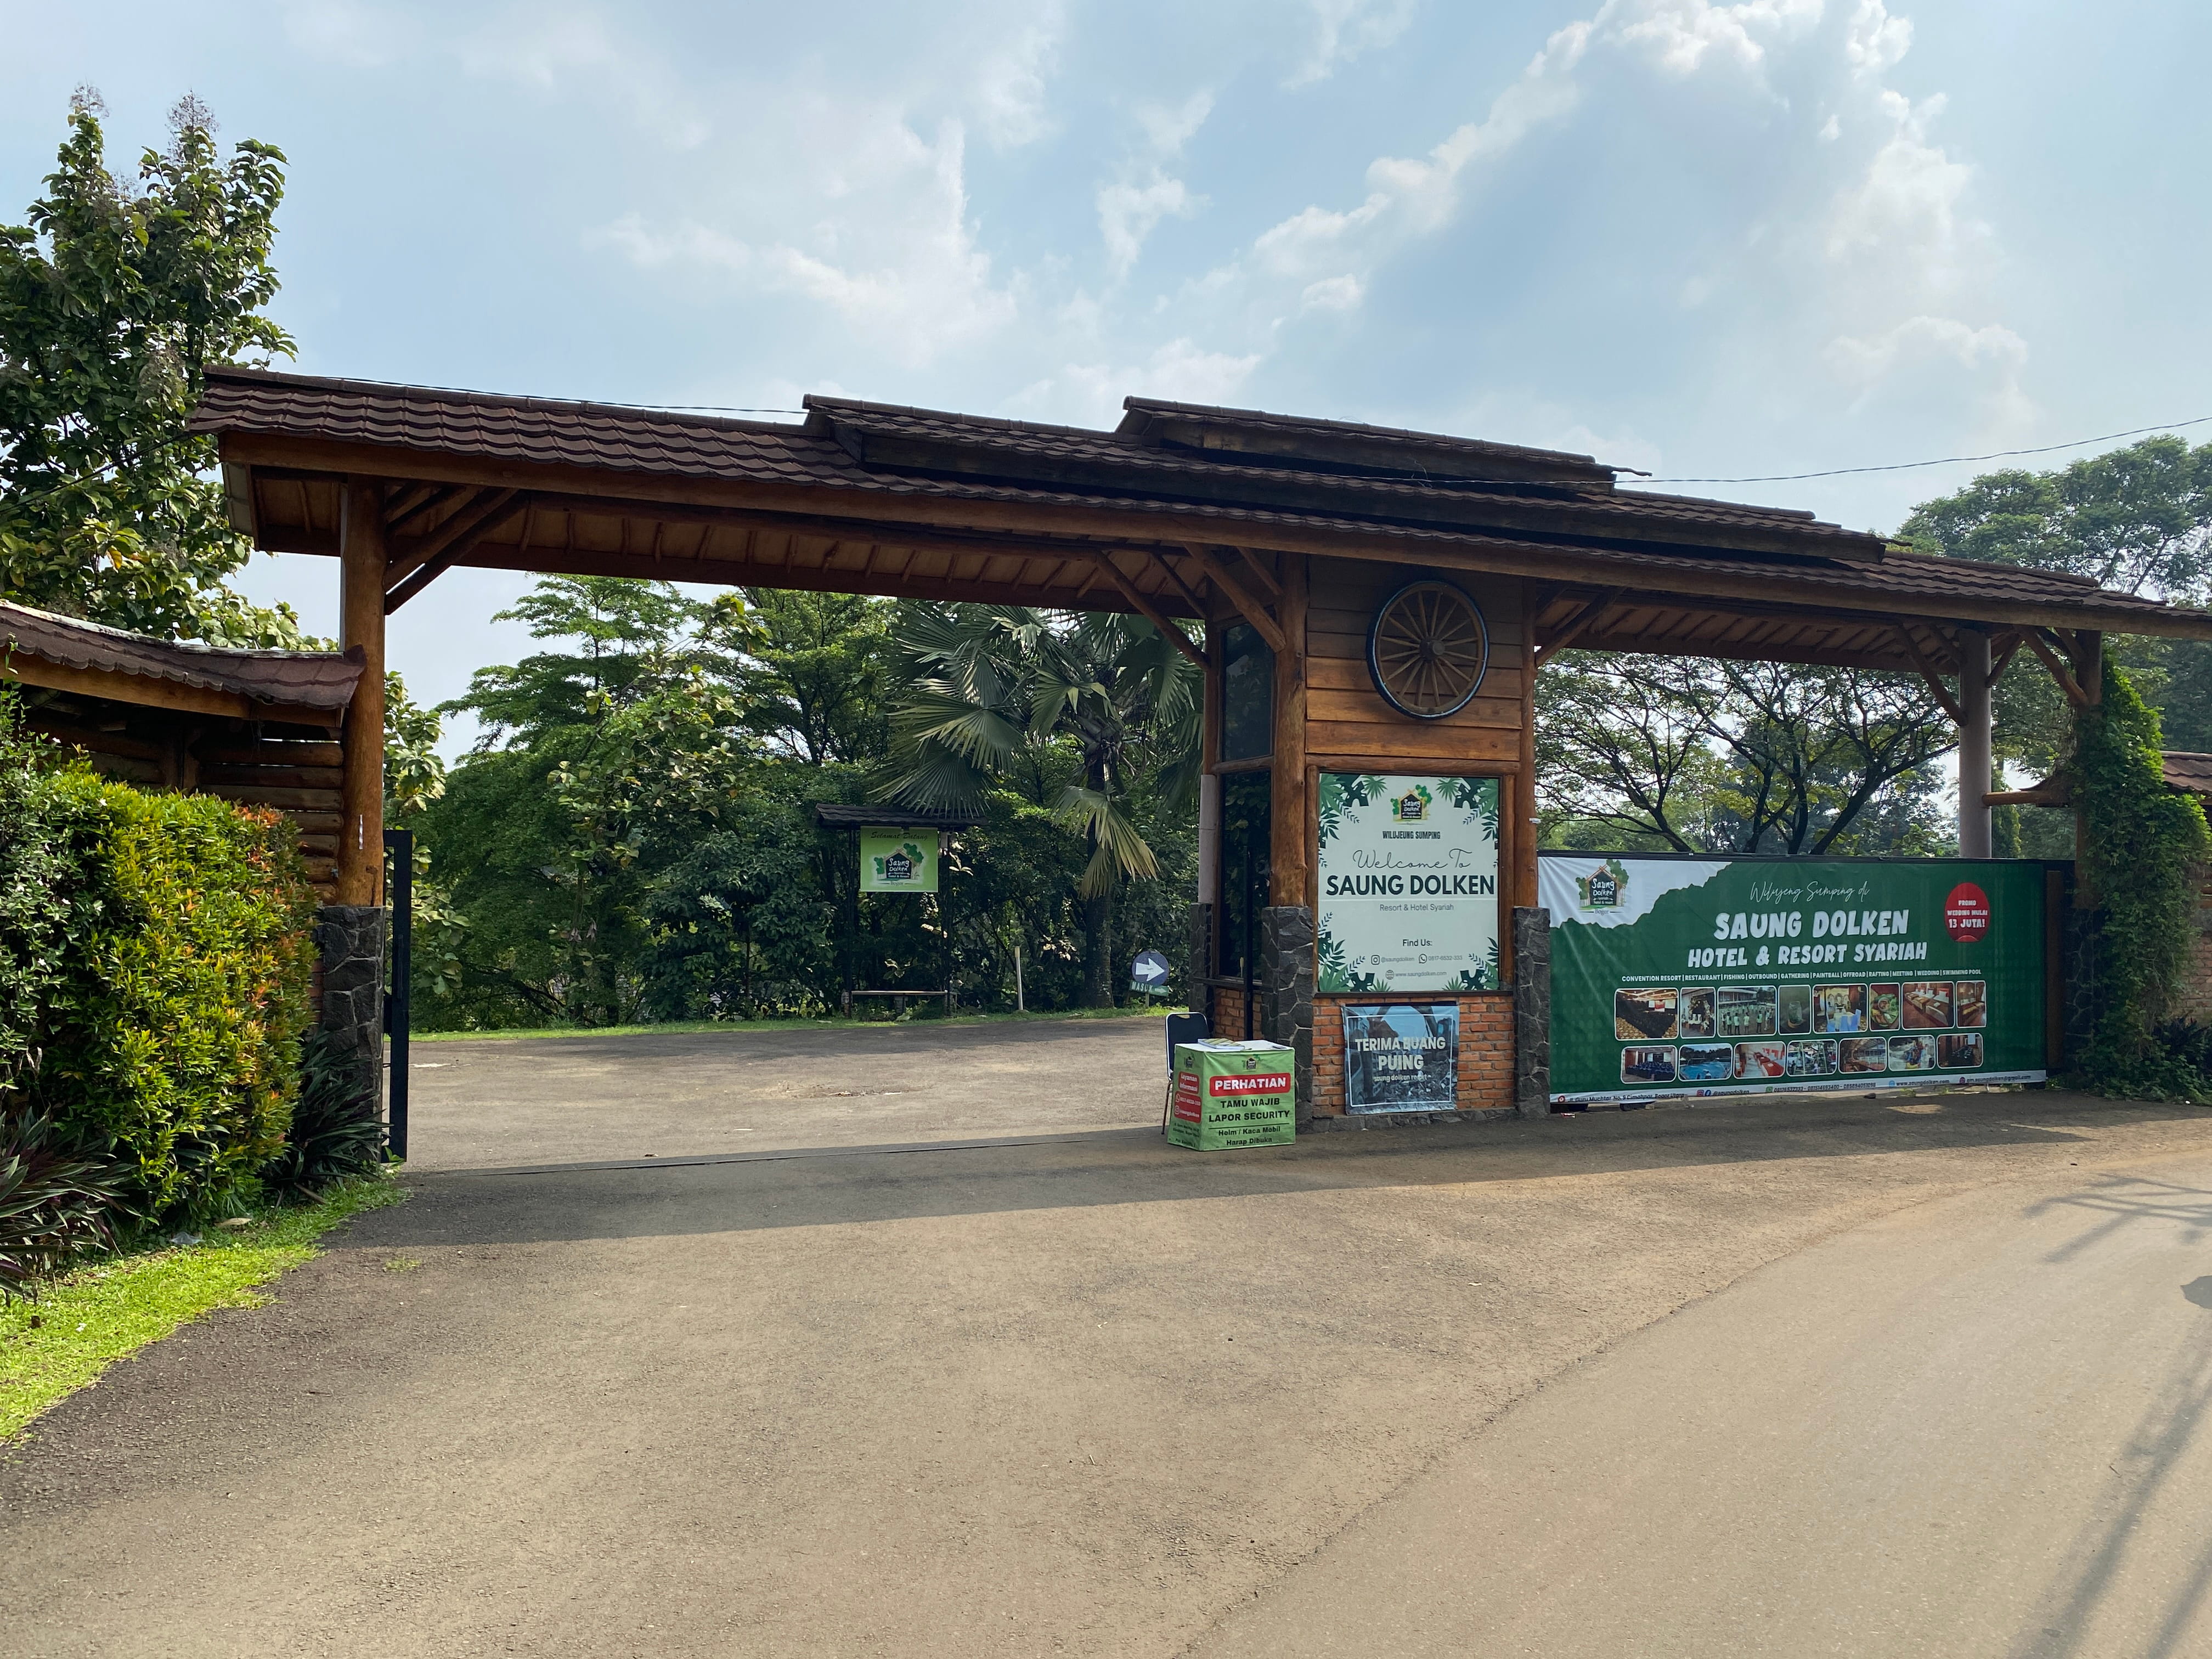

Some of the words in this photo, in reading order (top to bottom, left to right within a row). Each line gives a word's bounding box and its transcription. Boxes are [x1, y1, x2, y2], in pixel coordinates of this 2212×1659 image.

[1403, 799, 1420, 808] Saung
[902, 832, 928, 841] Datang
[888, 858, 910, 867] Saung
[1352, 850, 1448, 868] Welcome
[1449, 848, 1472, 868] To
[1325, 875, 1404, 895] SAUNG
[1410, 875, 1494, 895] DOLKEN
[1592, 878, 1615, 890] Saung
[1750, 881, 1804, 905] Wilujeng
[1807, 881, 1855, 902] Sumping
[1858, 881, 1870, 902] di
[1713, 911, 1802, 940] SAUNG
[1812, 909, 1909, 938] DOLKEN
[1949, 919, 1957, 928] 13
[1960, 918, 1985, 928] JUTA!
[1688, 946, 1748, 968] HOTEL
[1755, 945, 1770, 966] &
[1778, 944, 1847, 965] RESORT
[1853, 941, 1927, 963] SYARIAH
[1131, 981, 1153, 992] MASUK
[1355, 1037, 1401, 1052] TERIMA
[1403, 1037, 1446, 1051] BUANG
[1378, 1054, 1424, 1070] PUING
[1215, 1077, 1286, 1090] PERHATIAN
[1220, 1100, 1248, 1108] TAMU
[1251, 1098, 1280, 1106] WAJIB
[1209, 1114, 1241, 1122] LAPOR
[1244, 1110, 1290, 1120] SECURITY
